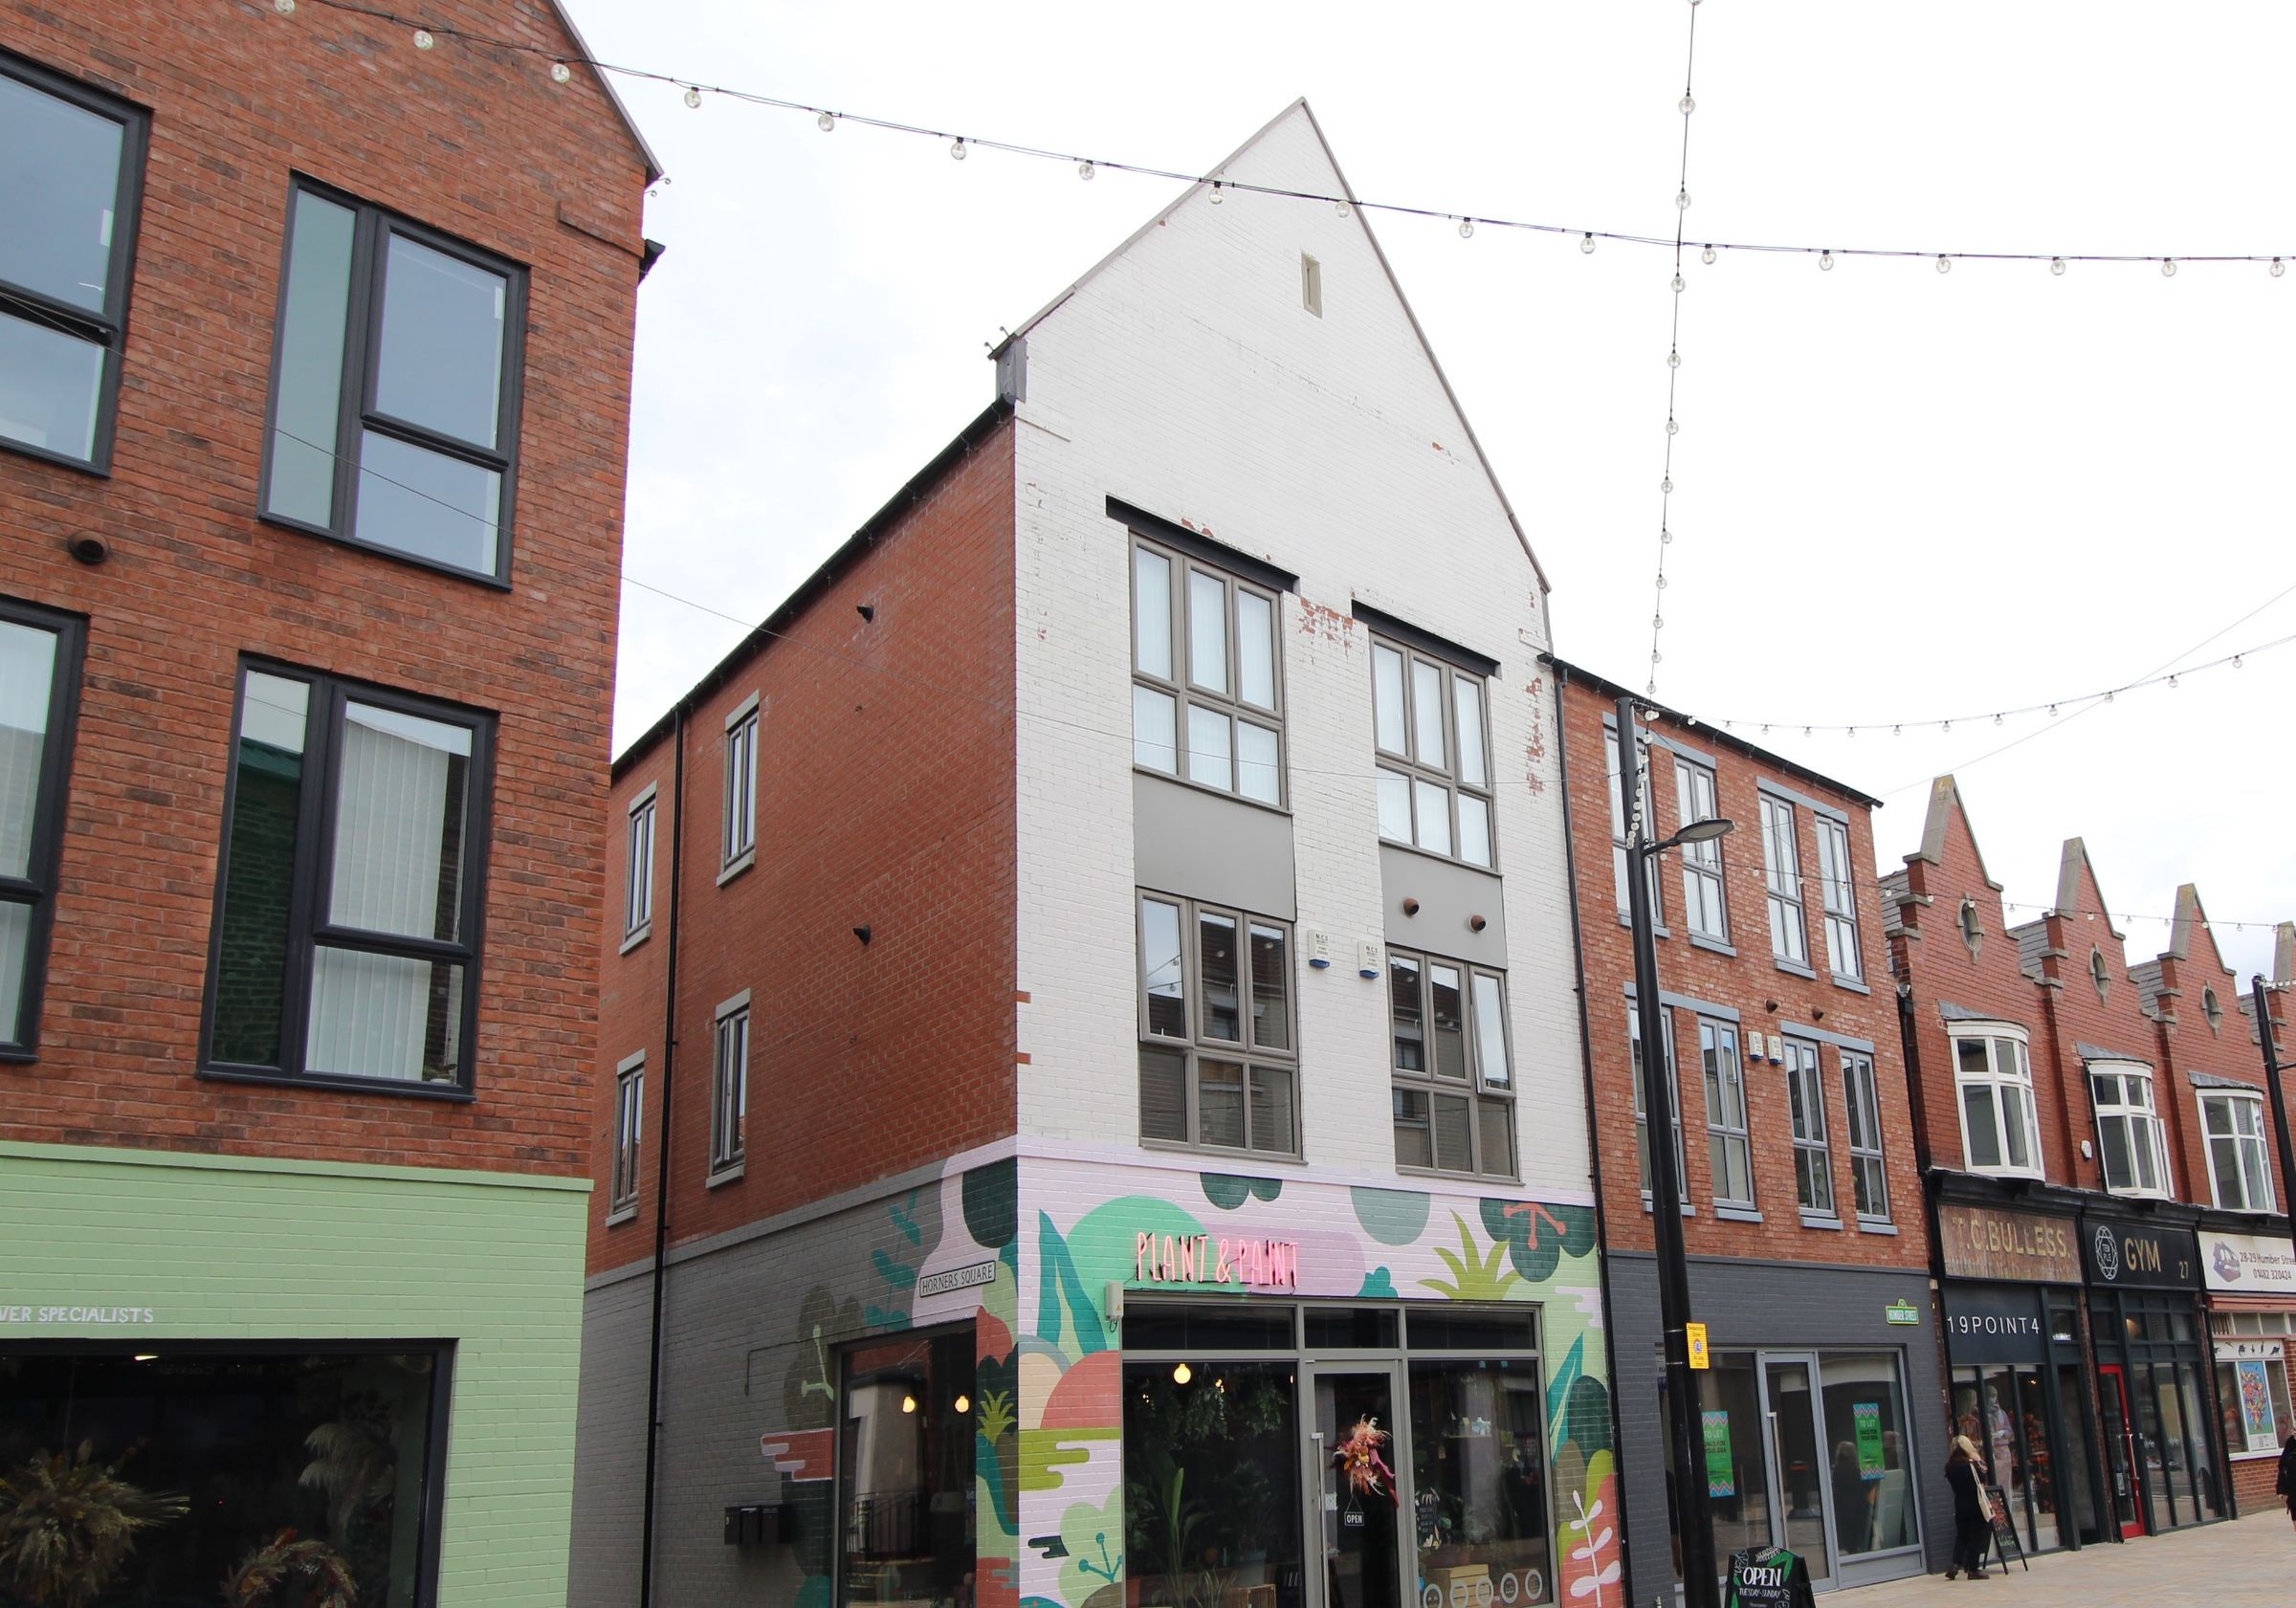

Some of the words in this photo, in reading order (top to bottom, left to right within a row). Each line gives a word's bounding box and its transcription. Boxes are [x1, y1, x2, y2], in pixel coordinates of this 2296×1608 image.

[1137, 1231, 1209, 1283] PLANT
[1215, 1238, 1231, 1284] &
[1238, 1239, 1299, 1287] PAINT
[2125, 1238, 2161, 1272] GYM
[2257, 1252, 2281, 1265] Humber
[2178, 1261, 2189, 1279] 27
[922, 1272, 959, 1294] HORNERS
[961, 1265, 993, 1286] SQUARE
[38, 1307, 154, 1323] SPECIALISTS
[1947, 1315, 2040, 1334] 19POINT4
[1712, 1430, 1723, 1439] LET
[1346, 1514, 1362, 1524] OPEN
[1743, 1567, 1781, 1587] OPEN
